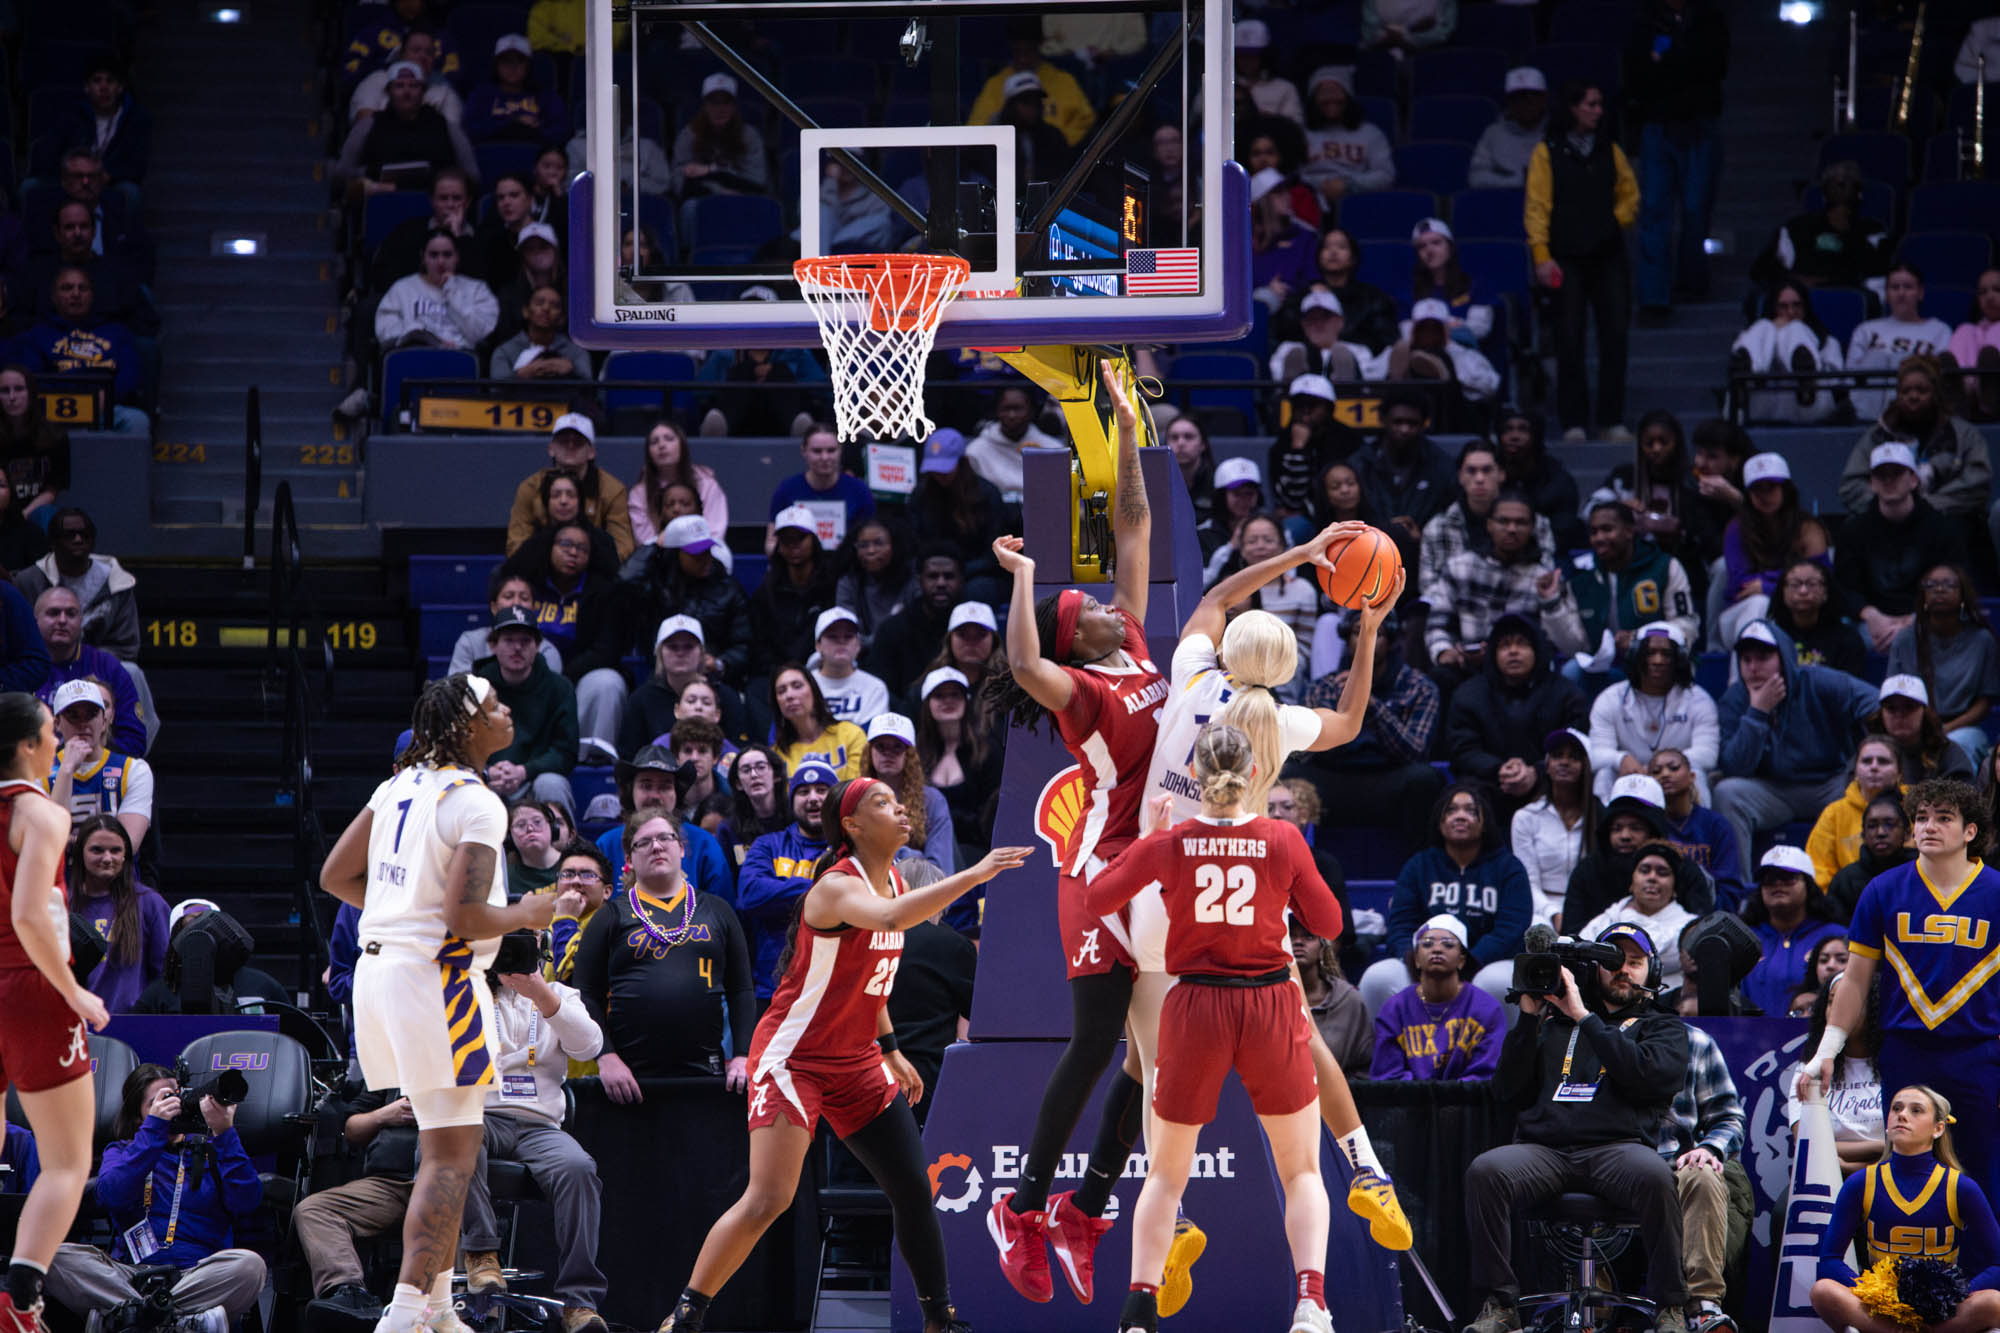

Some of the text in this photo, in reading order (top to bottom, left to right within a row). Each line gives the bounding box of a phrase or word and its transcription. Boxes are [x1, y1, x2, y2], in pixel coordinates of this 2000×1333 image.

[614, 308, 676, 323] SPALDING
[1867, 331, 1936, 357] LSU
[484, 404, 554, 427] 119
[155, 443, 206, 463] 224
[300, 444, 353, 465] 225
[1634, 579, 1660, 615] G
[147, 620, 199, 647] 118
[327, 621, 378, 649] 119
[824, 697, 862, 715] SU
[397, 798, 414, 854] 1
[1182, 837, 1267, 859] WEATHERS
[1194, 863, 1257, 926] 22
[1428, 881, 1499, 915] POLO
[1897, 912, 1991, 950] LSU
[697, 956, 713, 989] 4
[863, 956, 901, 997] 23
[211, 1053, 269, 1071] LSU
[1867, 1219, 1955, 1256] LSU
